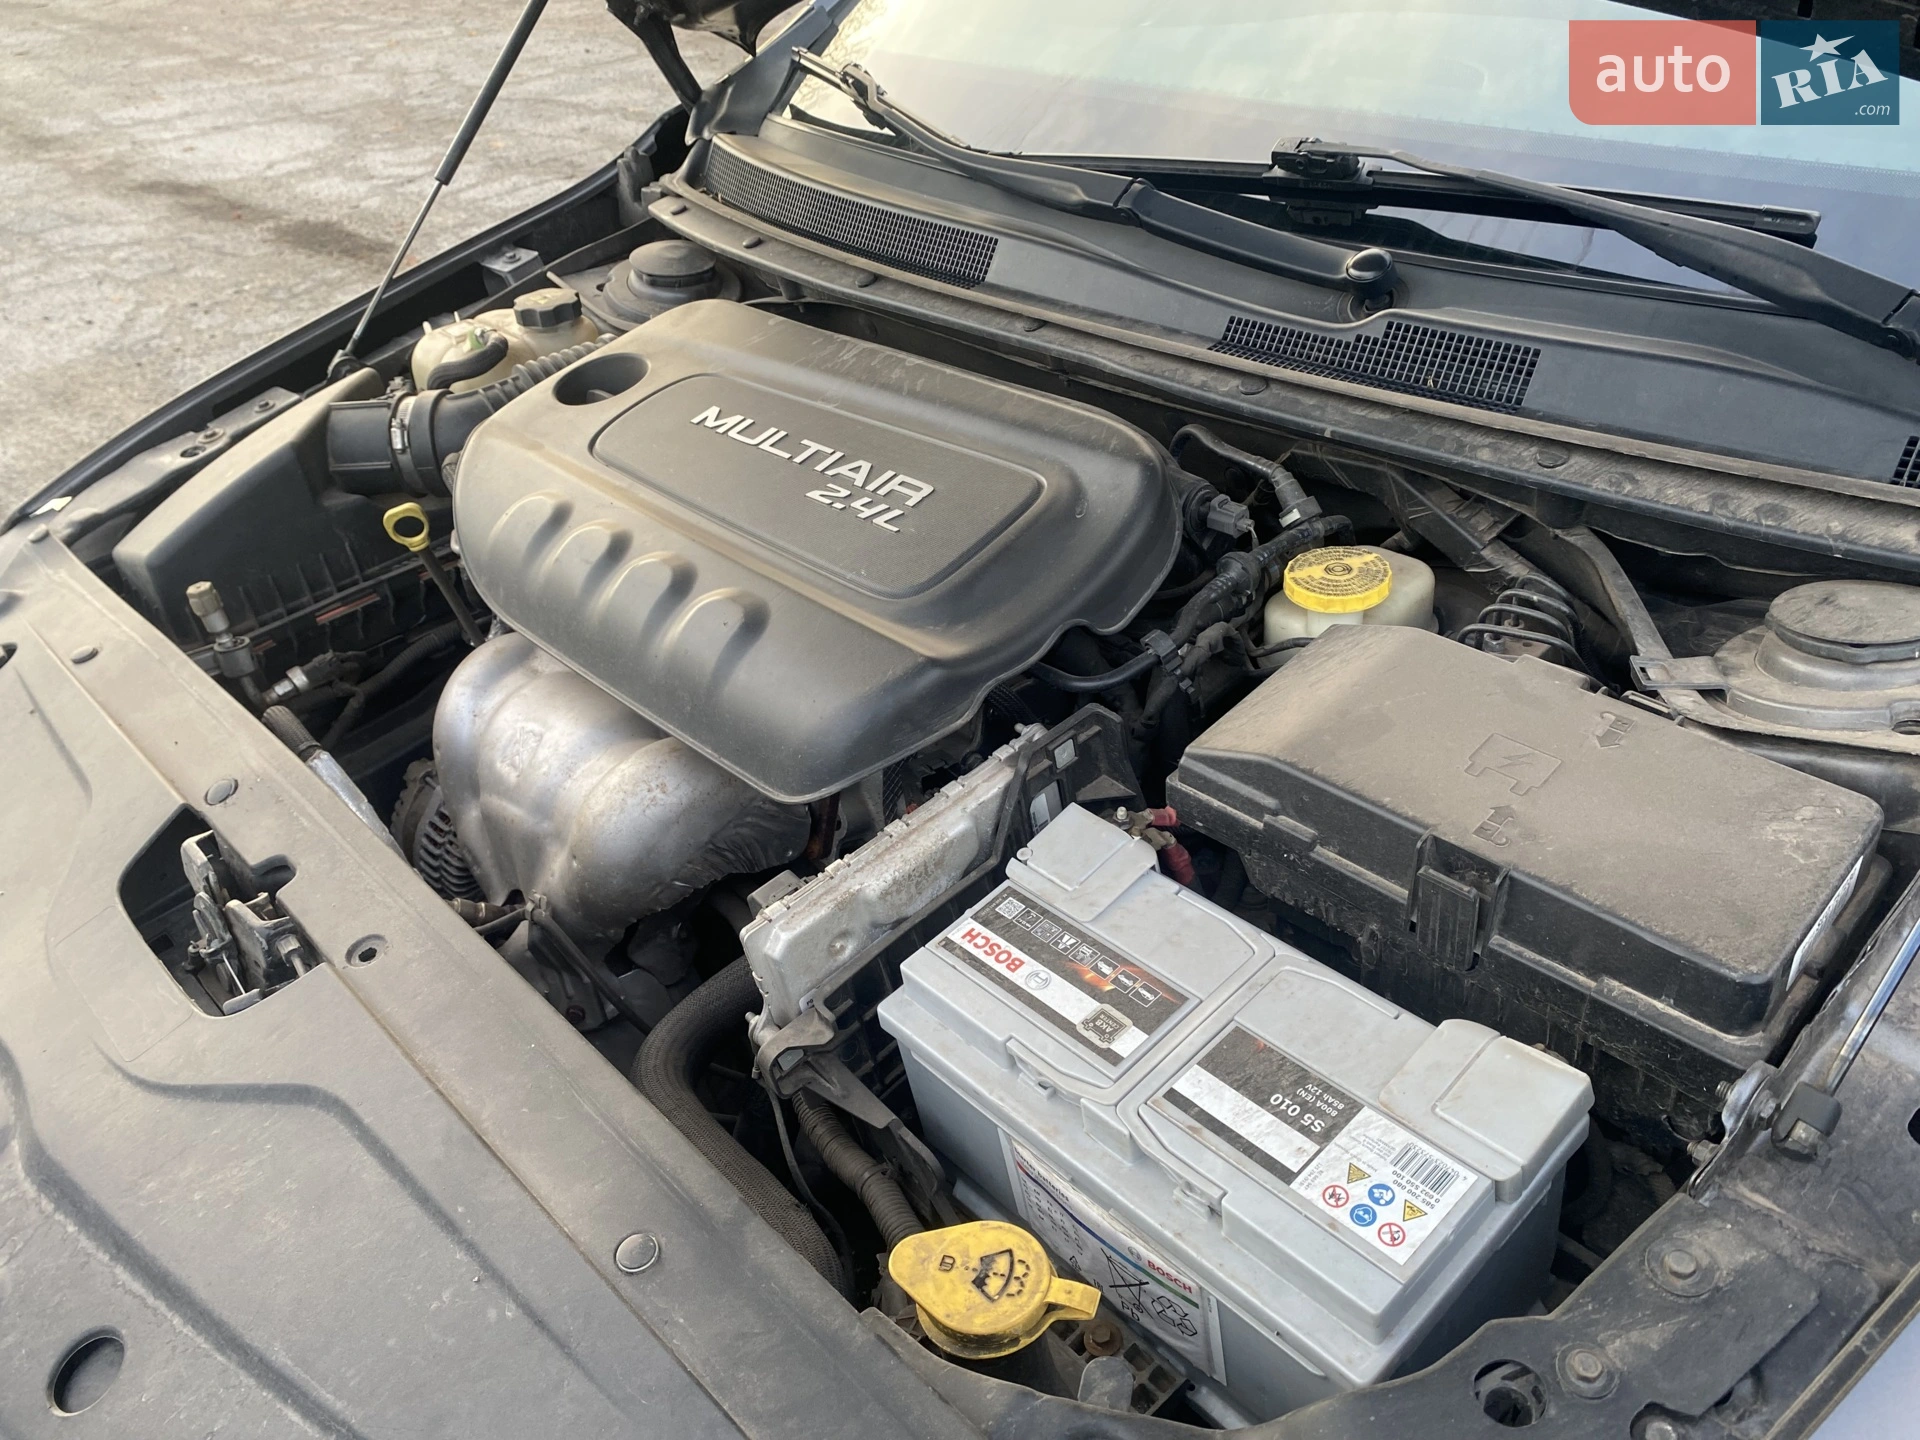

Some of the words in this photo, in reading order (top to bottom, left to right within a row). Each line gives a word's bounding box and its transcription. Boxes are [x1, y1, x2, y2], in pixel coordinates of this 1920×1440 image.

[690, 405, 935, 508] MULTIAIR
[805, 483, 905, 533] 2.4L
[960, 927, 1025, 973] BOSCH
[1094, 1018, 1113, 1032] AKB
[1099, 1013, 1119, 1029] CENTER
[1295, 1087, 1316, 1102] (EN)
[1304, 1083, 1322, 1095] 12V
[1268, 1092, 1301, 1117] 010
[1315, 1099, 1338, 1116] 800A
[1321, 1092, 1345, 1109] 85Ah
[1299, 1112, 1326, 1132] S5
[1391, 1169, 1405, 1181] 100
[1391, 1179, 1407, 1190] 080
[1405, 1188, 1421, 1200] 200
[1419, 1188, 1434, 1200] 092
[1420, 1197, 1435, 1209] 585
[1148, 1259, 1191, 1293] BOSCH
